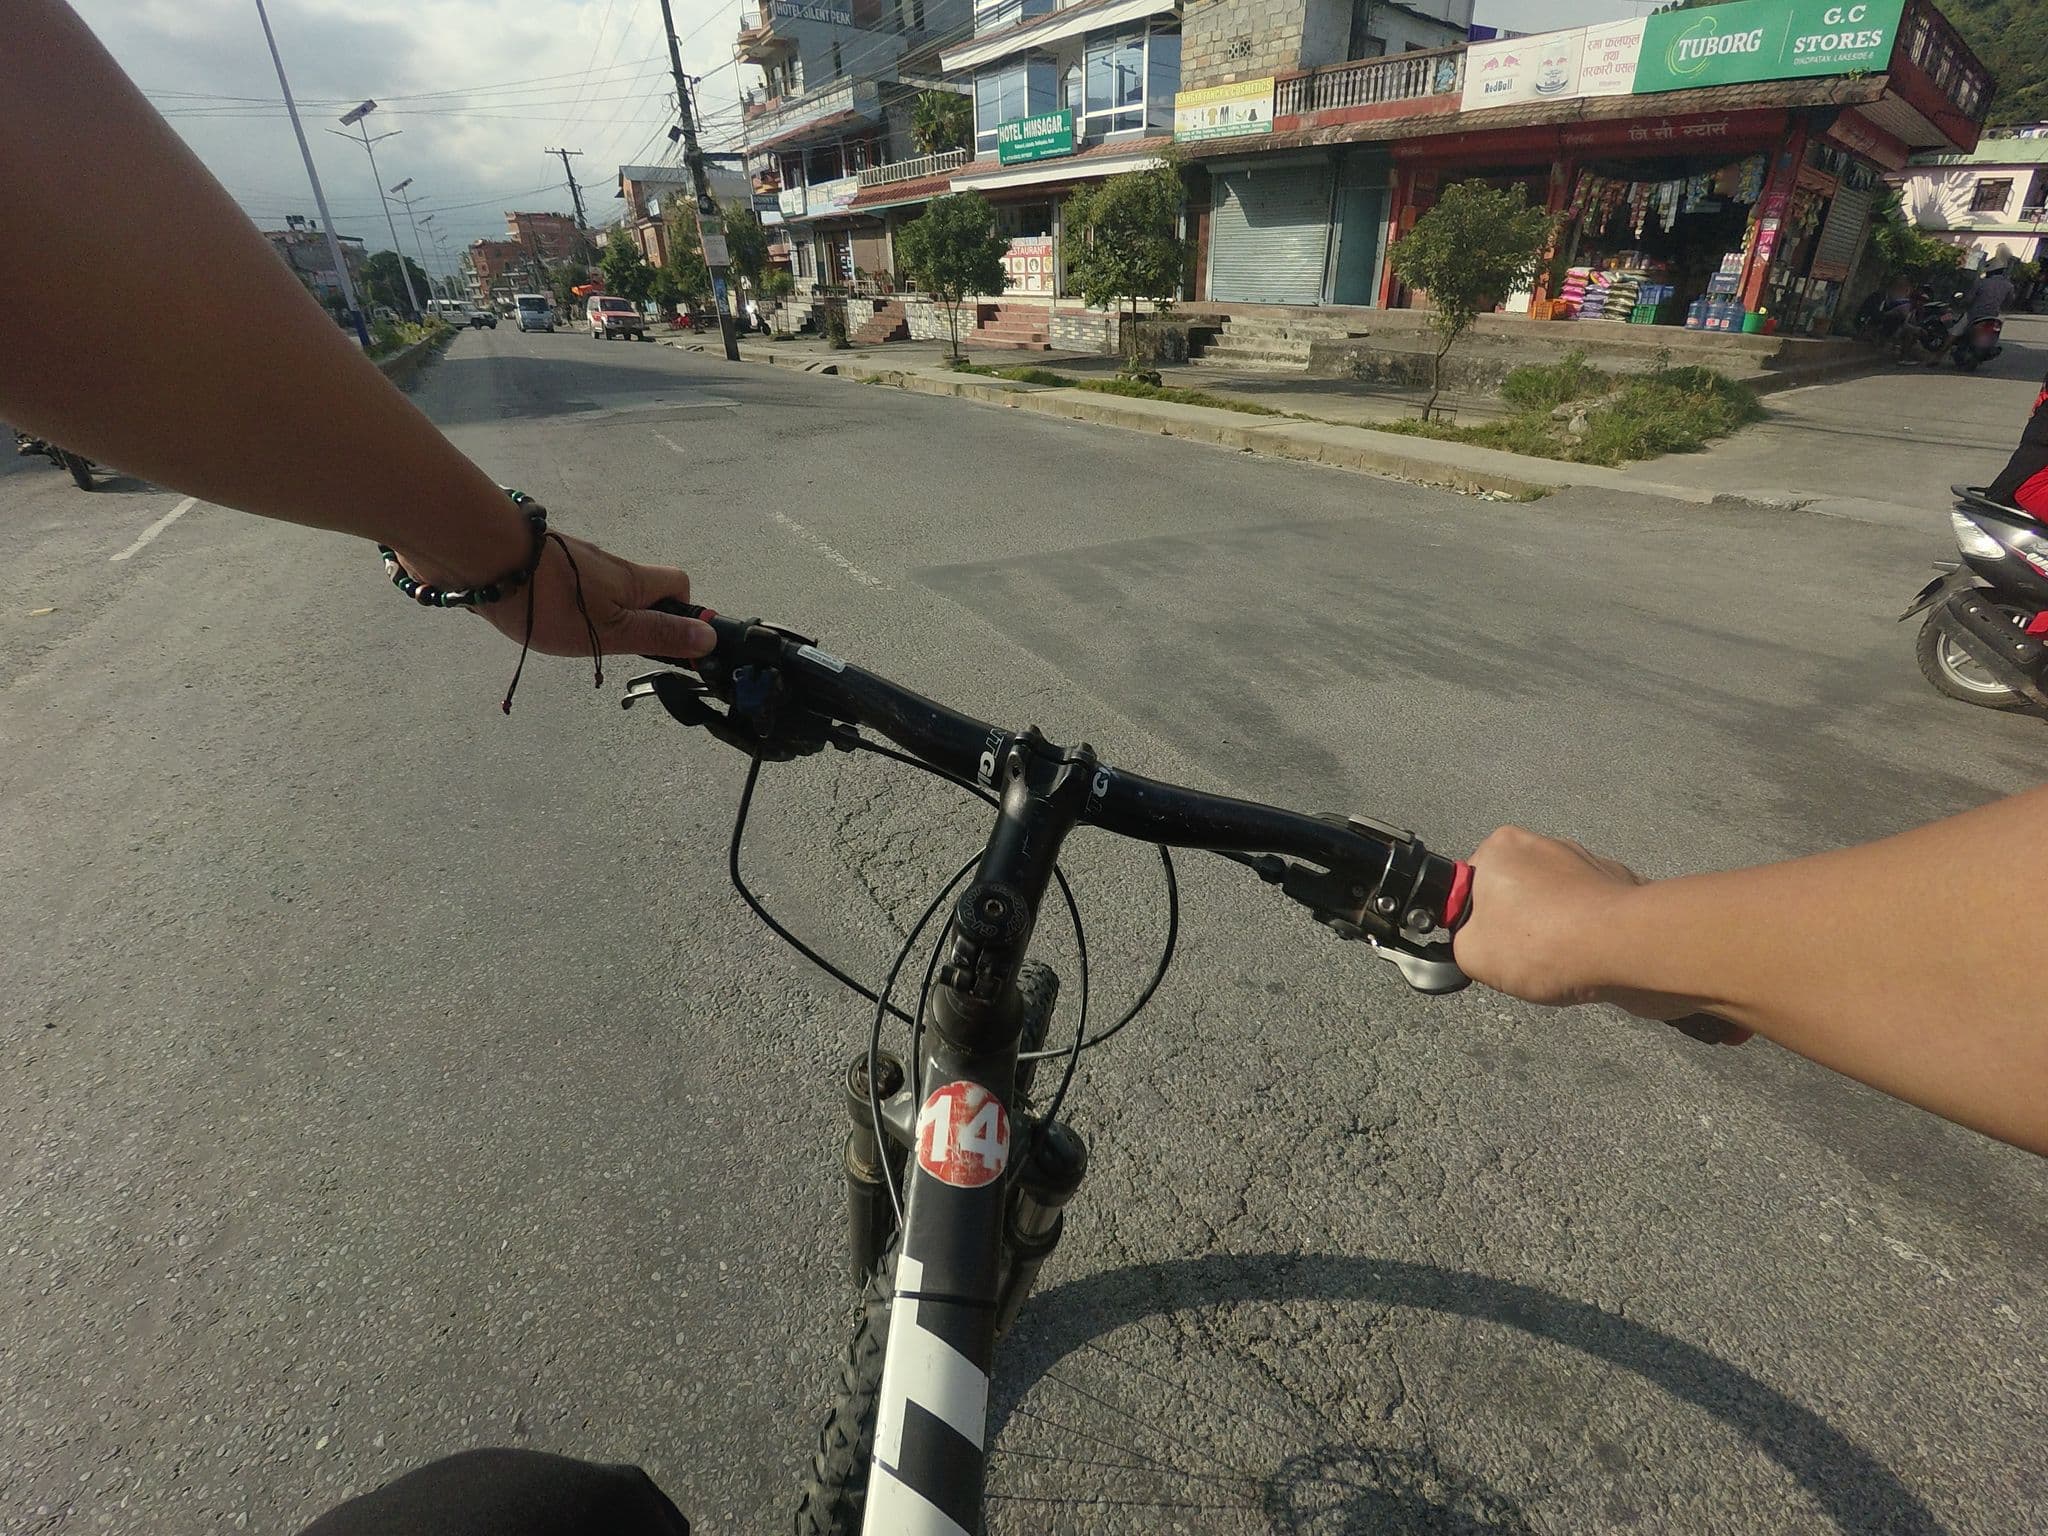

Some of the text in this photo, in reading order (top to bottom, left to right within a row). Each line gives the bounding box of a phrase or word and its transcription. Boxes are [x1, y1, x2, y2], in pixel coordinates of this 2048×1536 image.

[777, 2, 852, 25] HOTEL SILENT PEAK
[1678, 29, 1764, 62] TUBORG
[1793, 30, 1883, 53] STORES
[1603, 51, 1620, 61] तथा
[999, 115, 1063, 143] HOTEL HIMSAGAR
[919, 1094, 1008, 1170] 14
